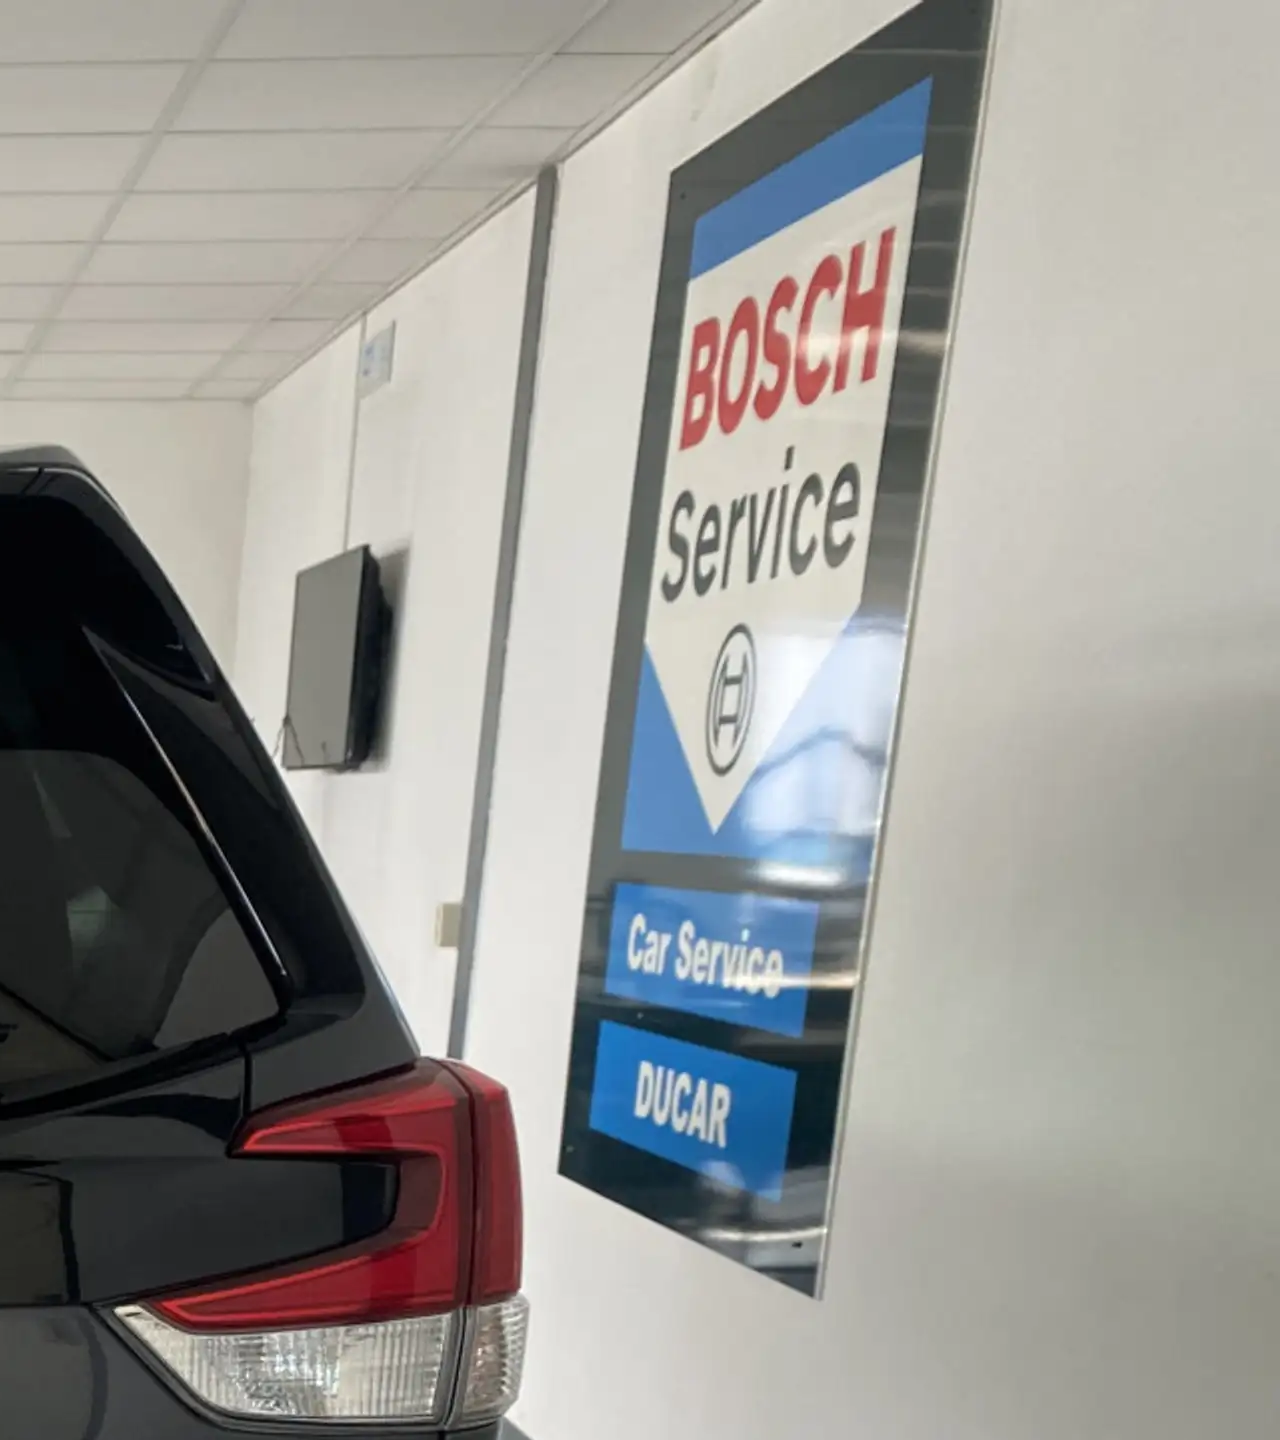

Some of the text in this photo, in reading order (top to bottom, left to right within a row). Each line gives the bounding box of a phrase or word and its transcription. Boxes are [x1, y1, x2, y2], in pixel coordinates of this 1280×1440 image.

[678, 226, 897, 452] BOSCH
[660, 446, 861, 603] Service
[627, 913, 783, 998] Car Service
[634, 1060, 731, 1148] DUCAR
